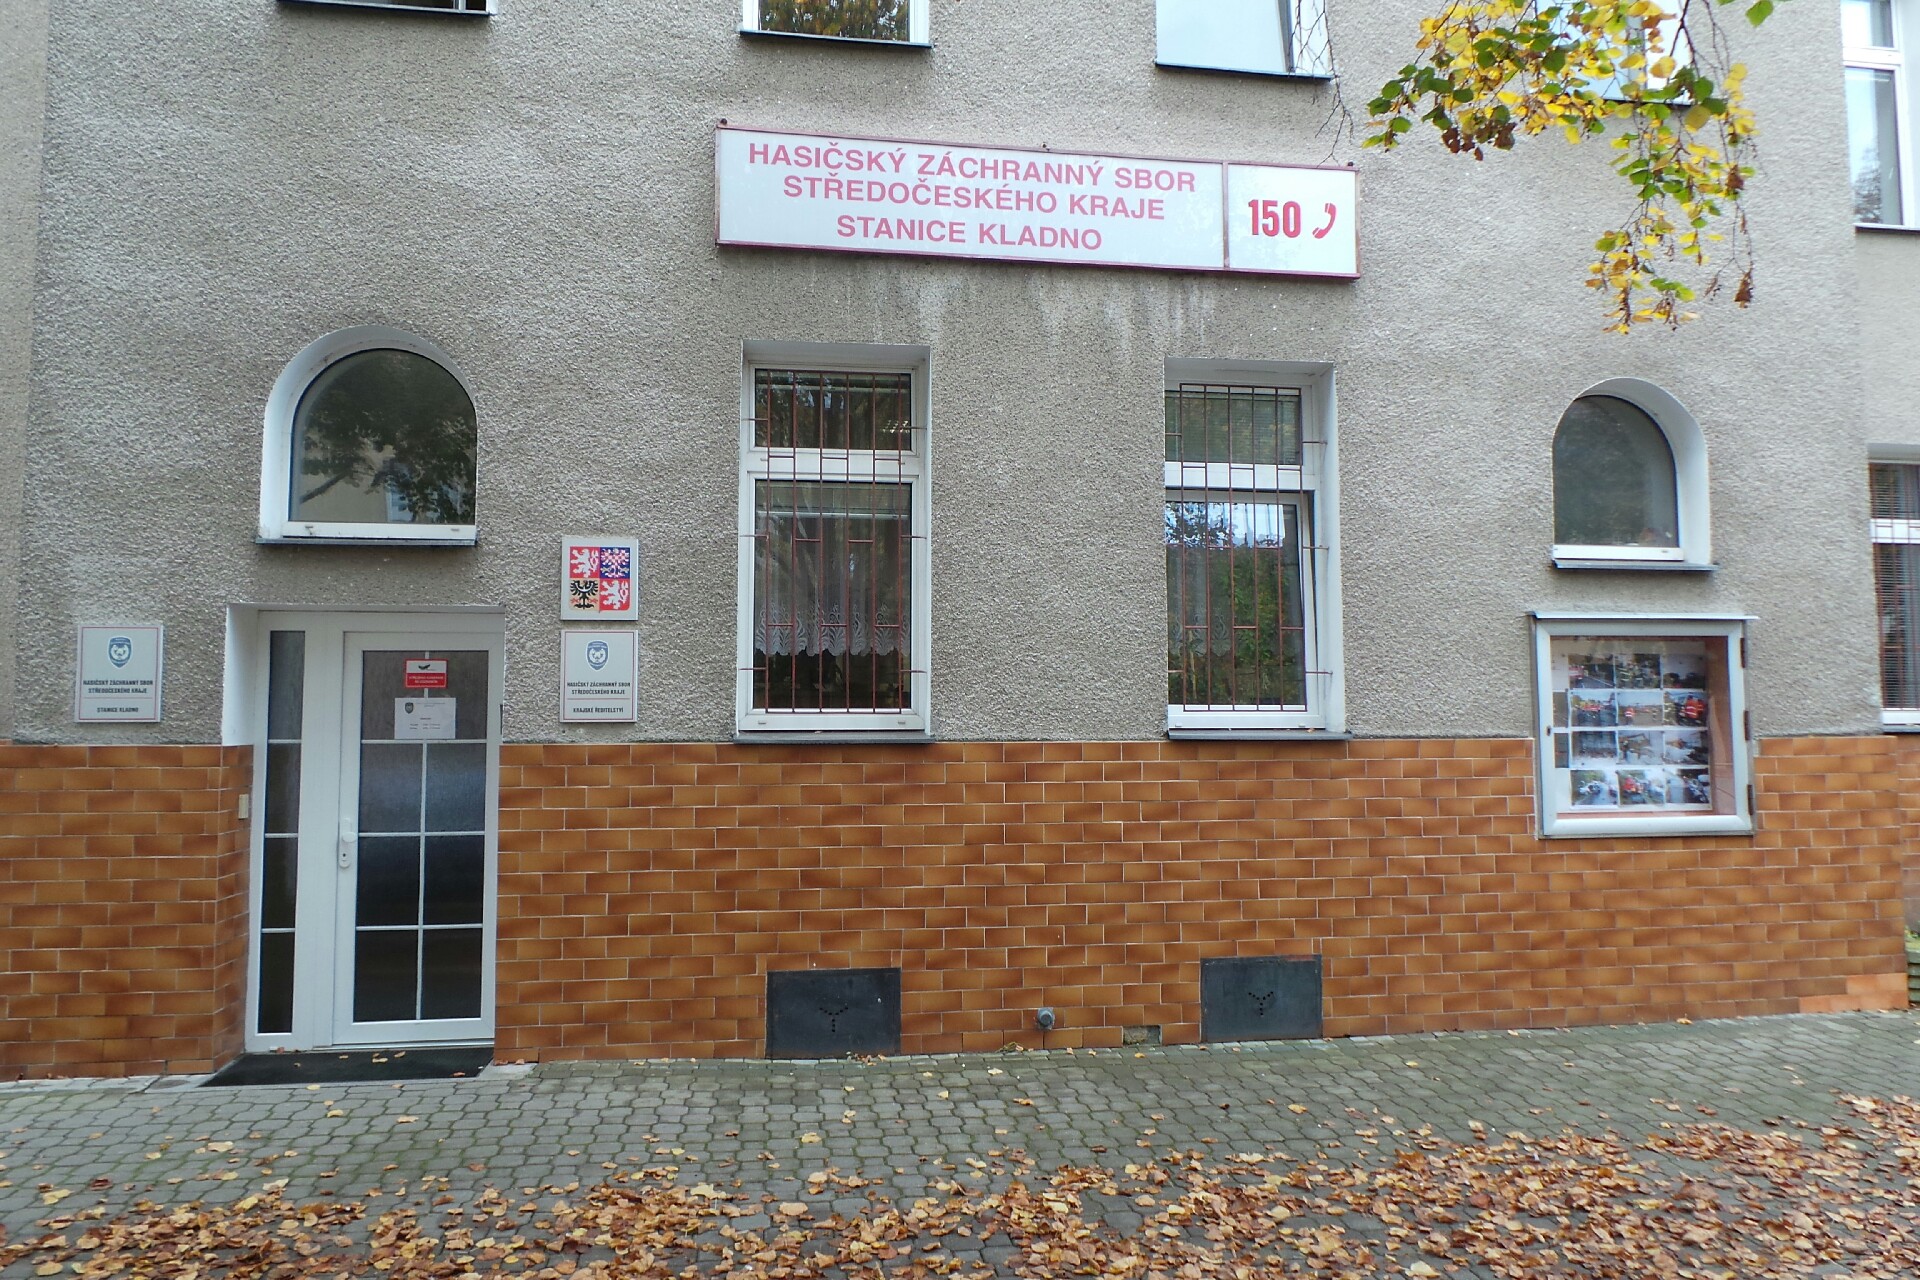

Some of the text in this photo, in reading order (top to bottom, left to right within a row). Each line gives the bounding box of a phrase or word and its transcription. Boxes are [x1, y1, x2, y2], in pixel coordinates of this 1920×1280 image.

[749, 141, 1196, 192] HASIČSKÝ ZÁCHRANNÝ SBOR
[783, 172, 1165, 220] STŘEDOČESKÉHO KRAJE
[837, 214, 1102, 250] STANICE KLADNO
[1248, 199, 1301, 238] 150
